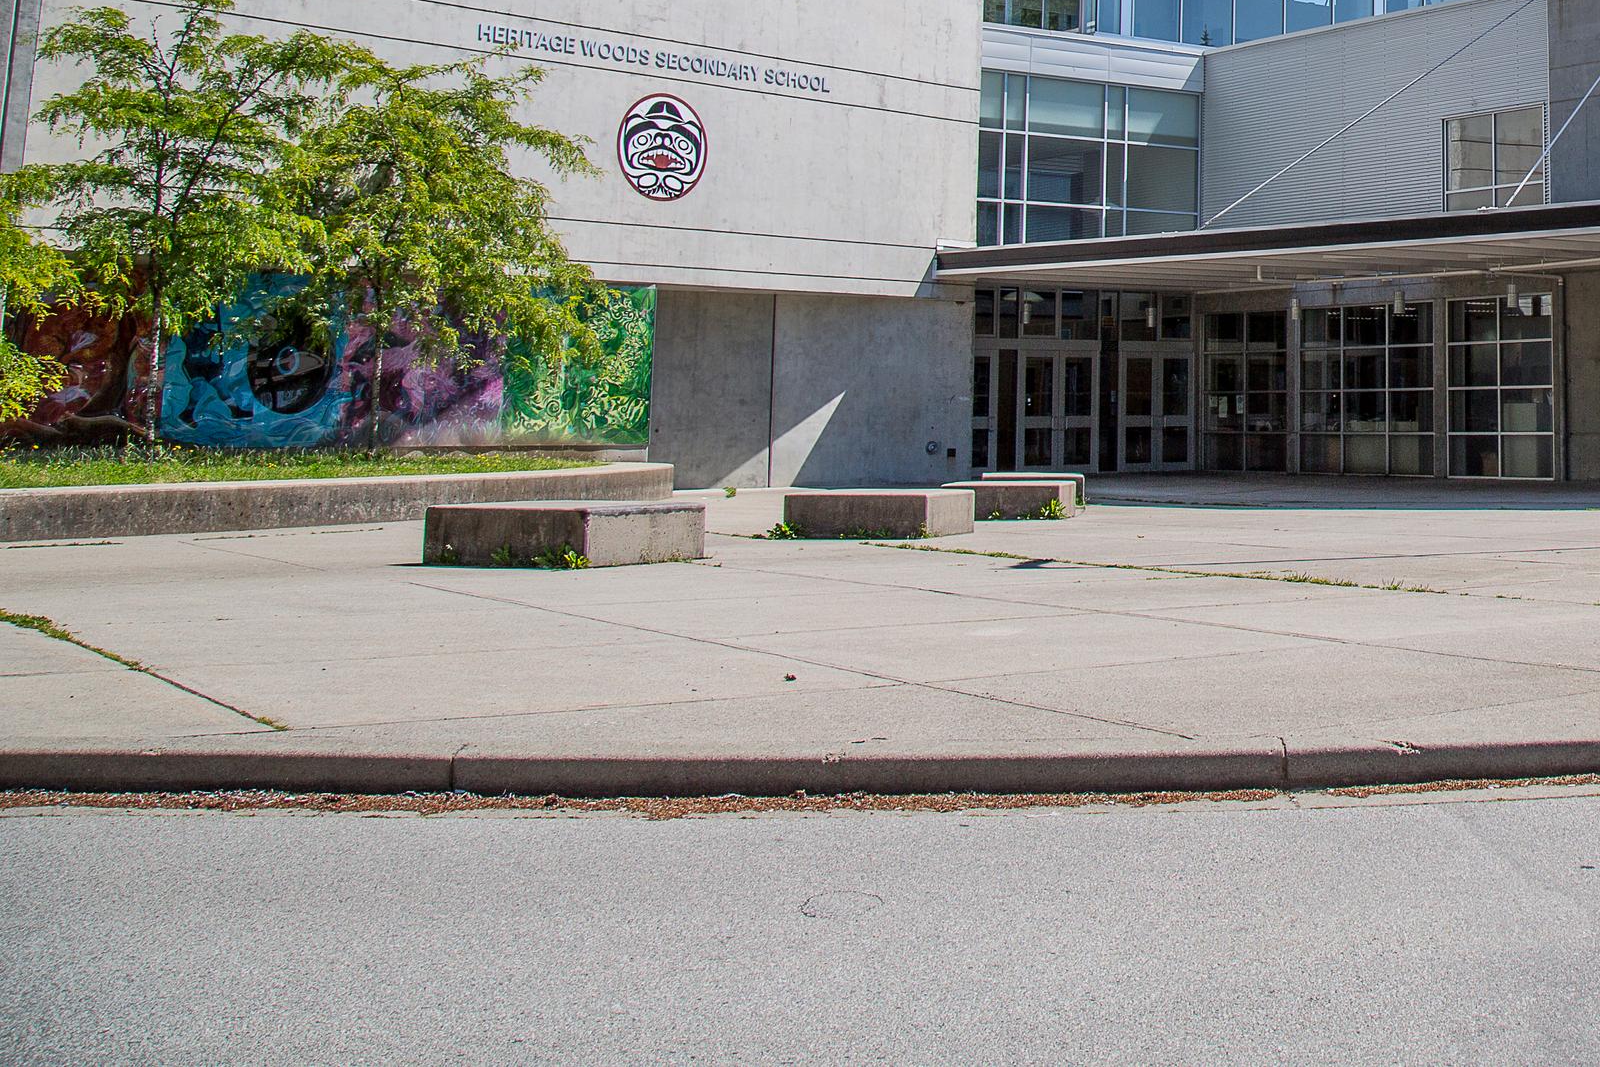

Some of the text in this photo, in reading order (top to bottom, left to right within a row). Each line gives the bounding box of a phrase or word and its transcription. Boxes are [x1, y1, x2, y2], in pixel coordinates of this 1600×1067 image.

[477, 23, 831, 94] HERITAGE WOODS SECONDARY SCHOOL
